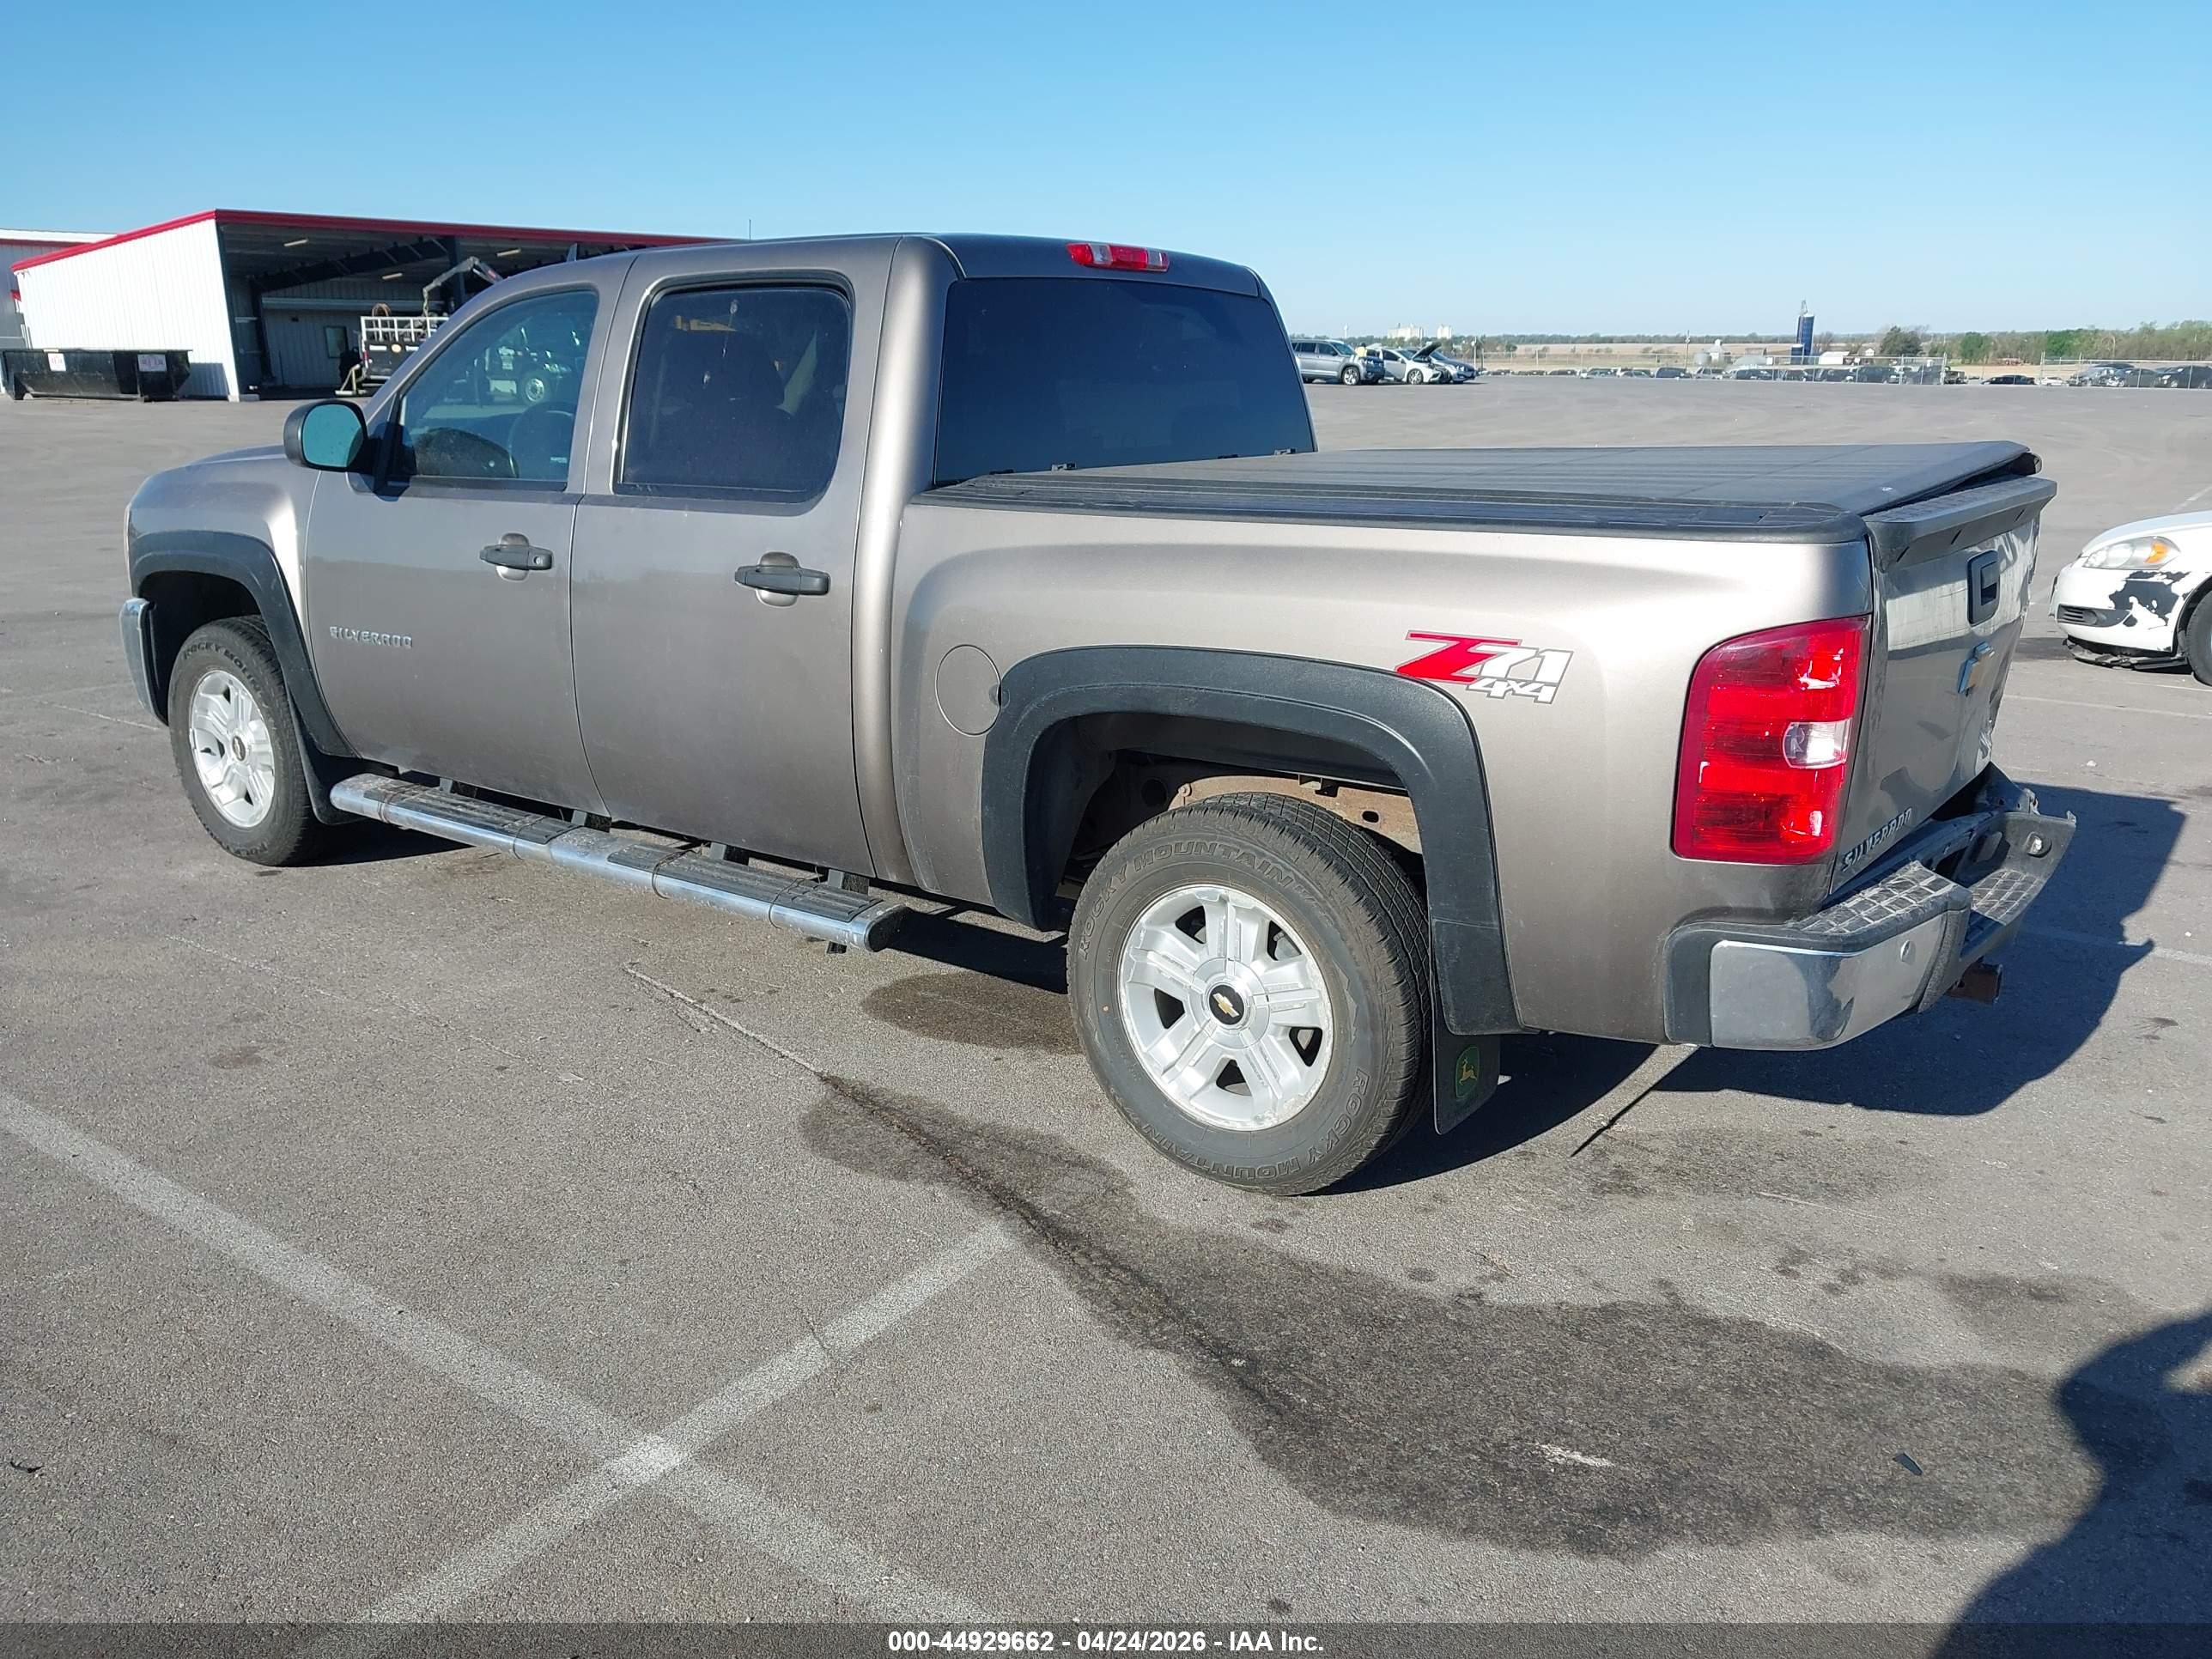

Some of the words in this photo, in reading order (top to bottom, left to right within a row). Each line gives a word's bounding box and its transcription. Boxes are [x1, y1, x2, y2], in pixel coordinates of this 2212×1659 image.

[330, 626, 413, 649] SILVERADO
[1395, 629, 1574, 687] Z71
[1842, 806, 1912, 872] SILVERADO
[1078, 860, 1128, 961] ROCKY
[1133, 840, 1295, 890] MOUNTAIN
[1307, 1067, 1370, 1168] ROCKY
[1141, 1122, 1302, 1180] MOUNTAIN
